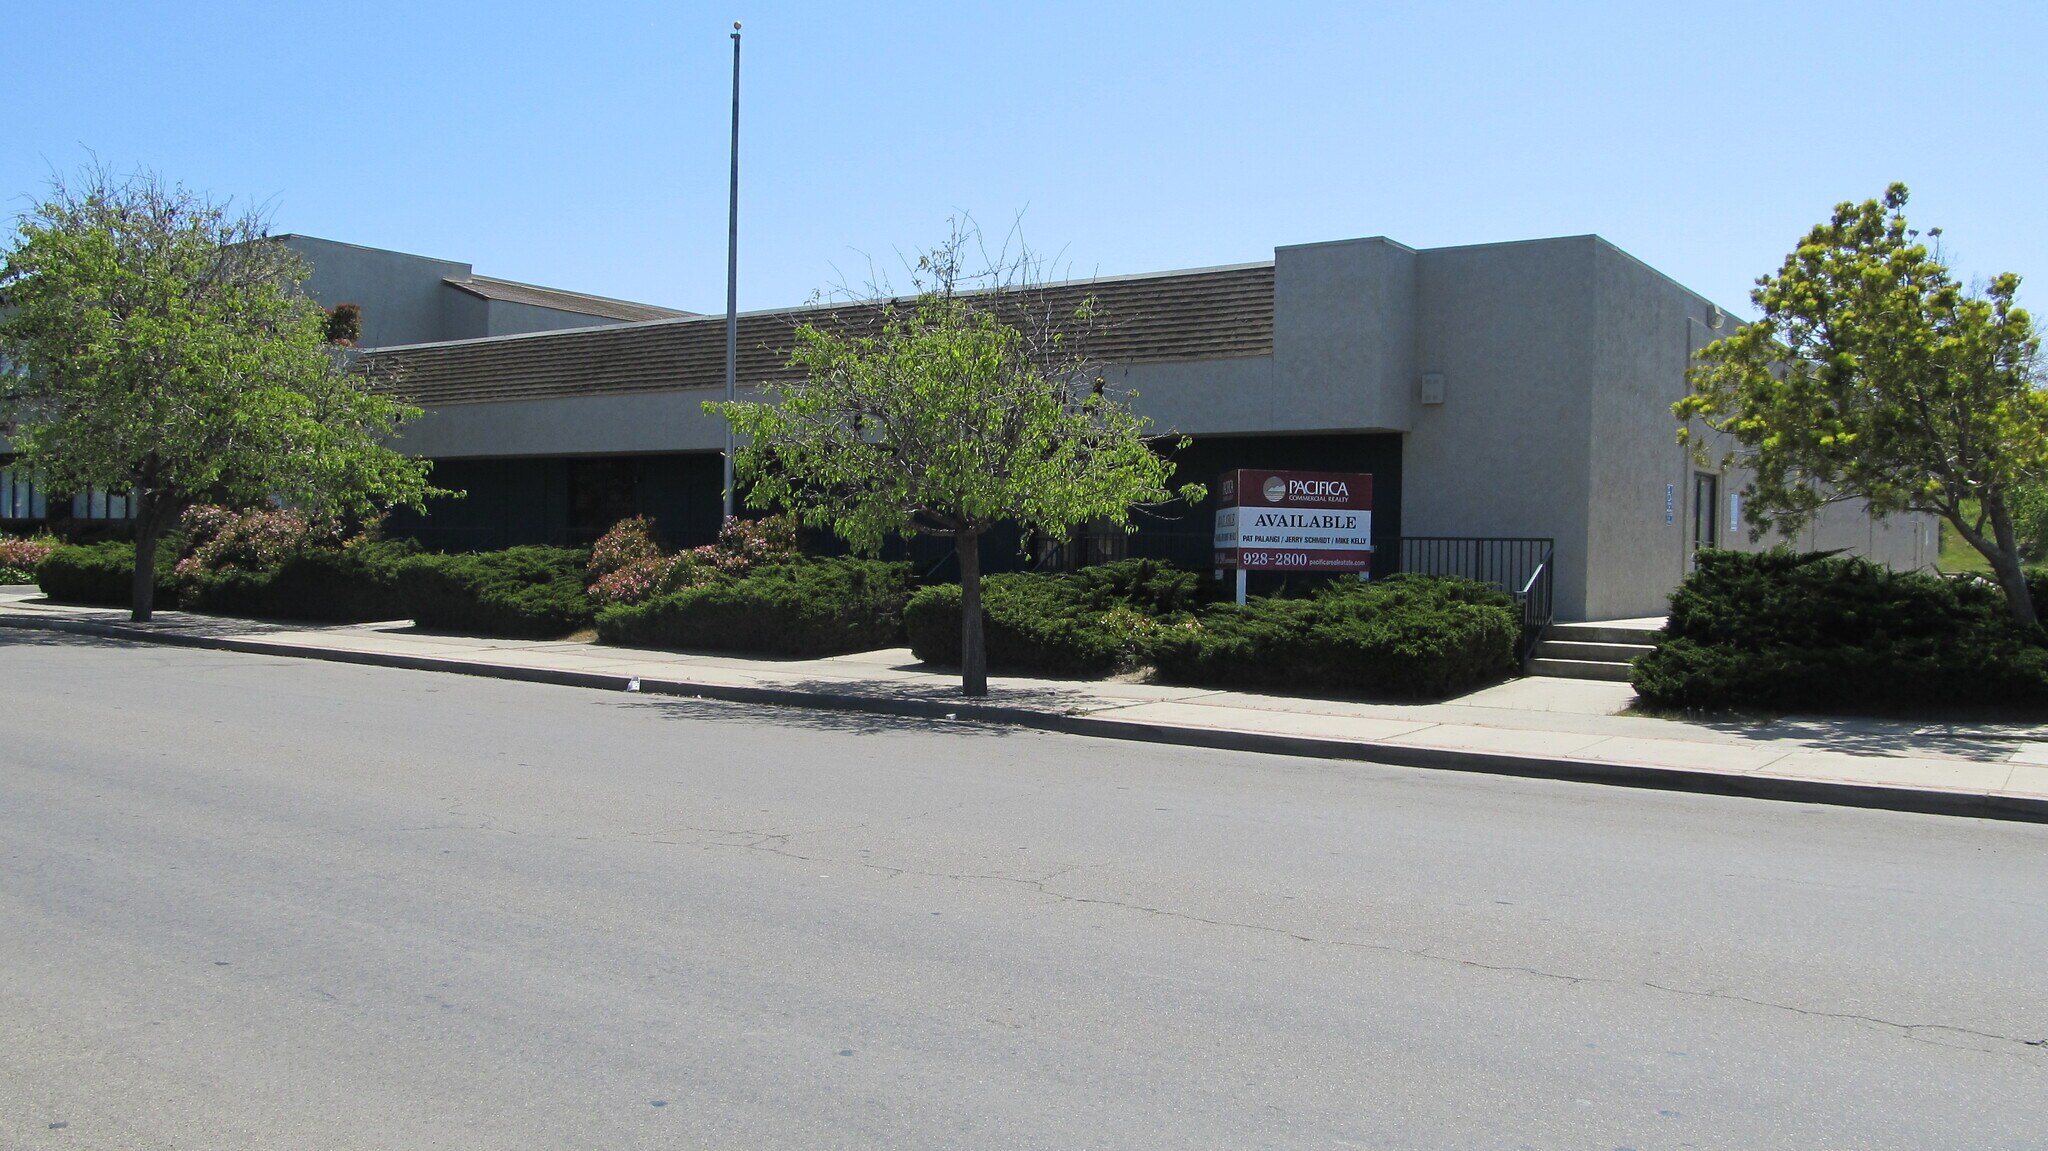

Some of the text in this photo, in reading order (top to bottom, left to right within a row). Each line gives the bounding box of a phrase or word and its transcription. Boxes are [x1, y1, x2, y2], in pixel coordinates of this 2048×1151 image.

[1289, 480, 1349, 496] PACIFICA
[1254, 513, 1357, 529] AVAILABLE
[1255, 535, 1280, 543] PALANGI
[1335, 537, 1350, 545] MIKE
[1350, 537, 1366, 545] KELLY
[1243, 552, 1307, 566] 928-2800
[1309, 559, 1366, 567] pacificarealestate.com
